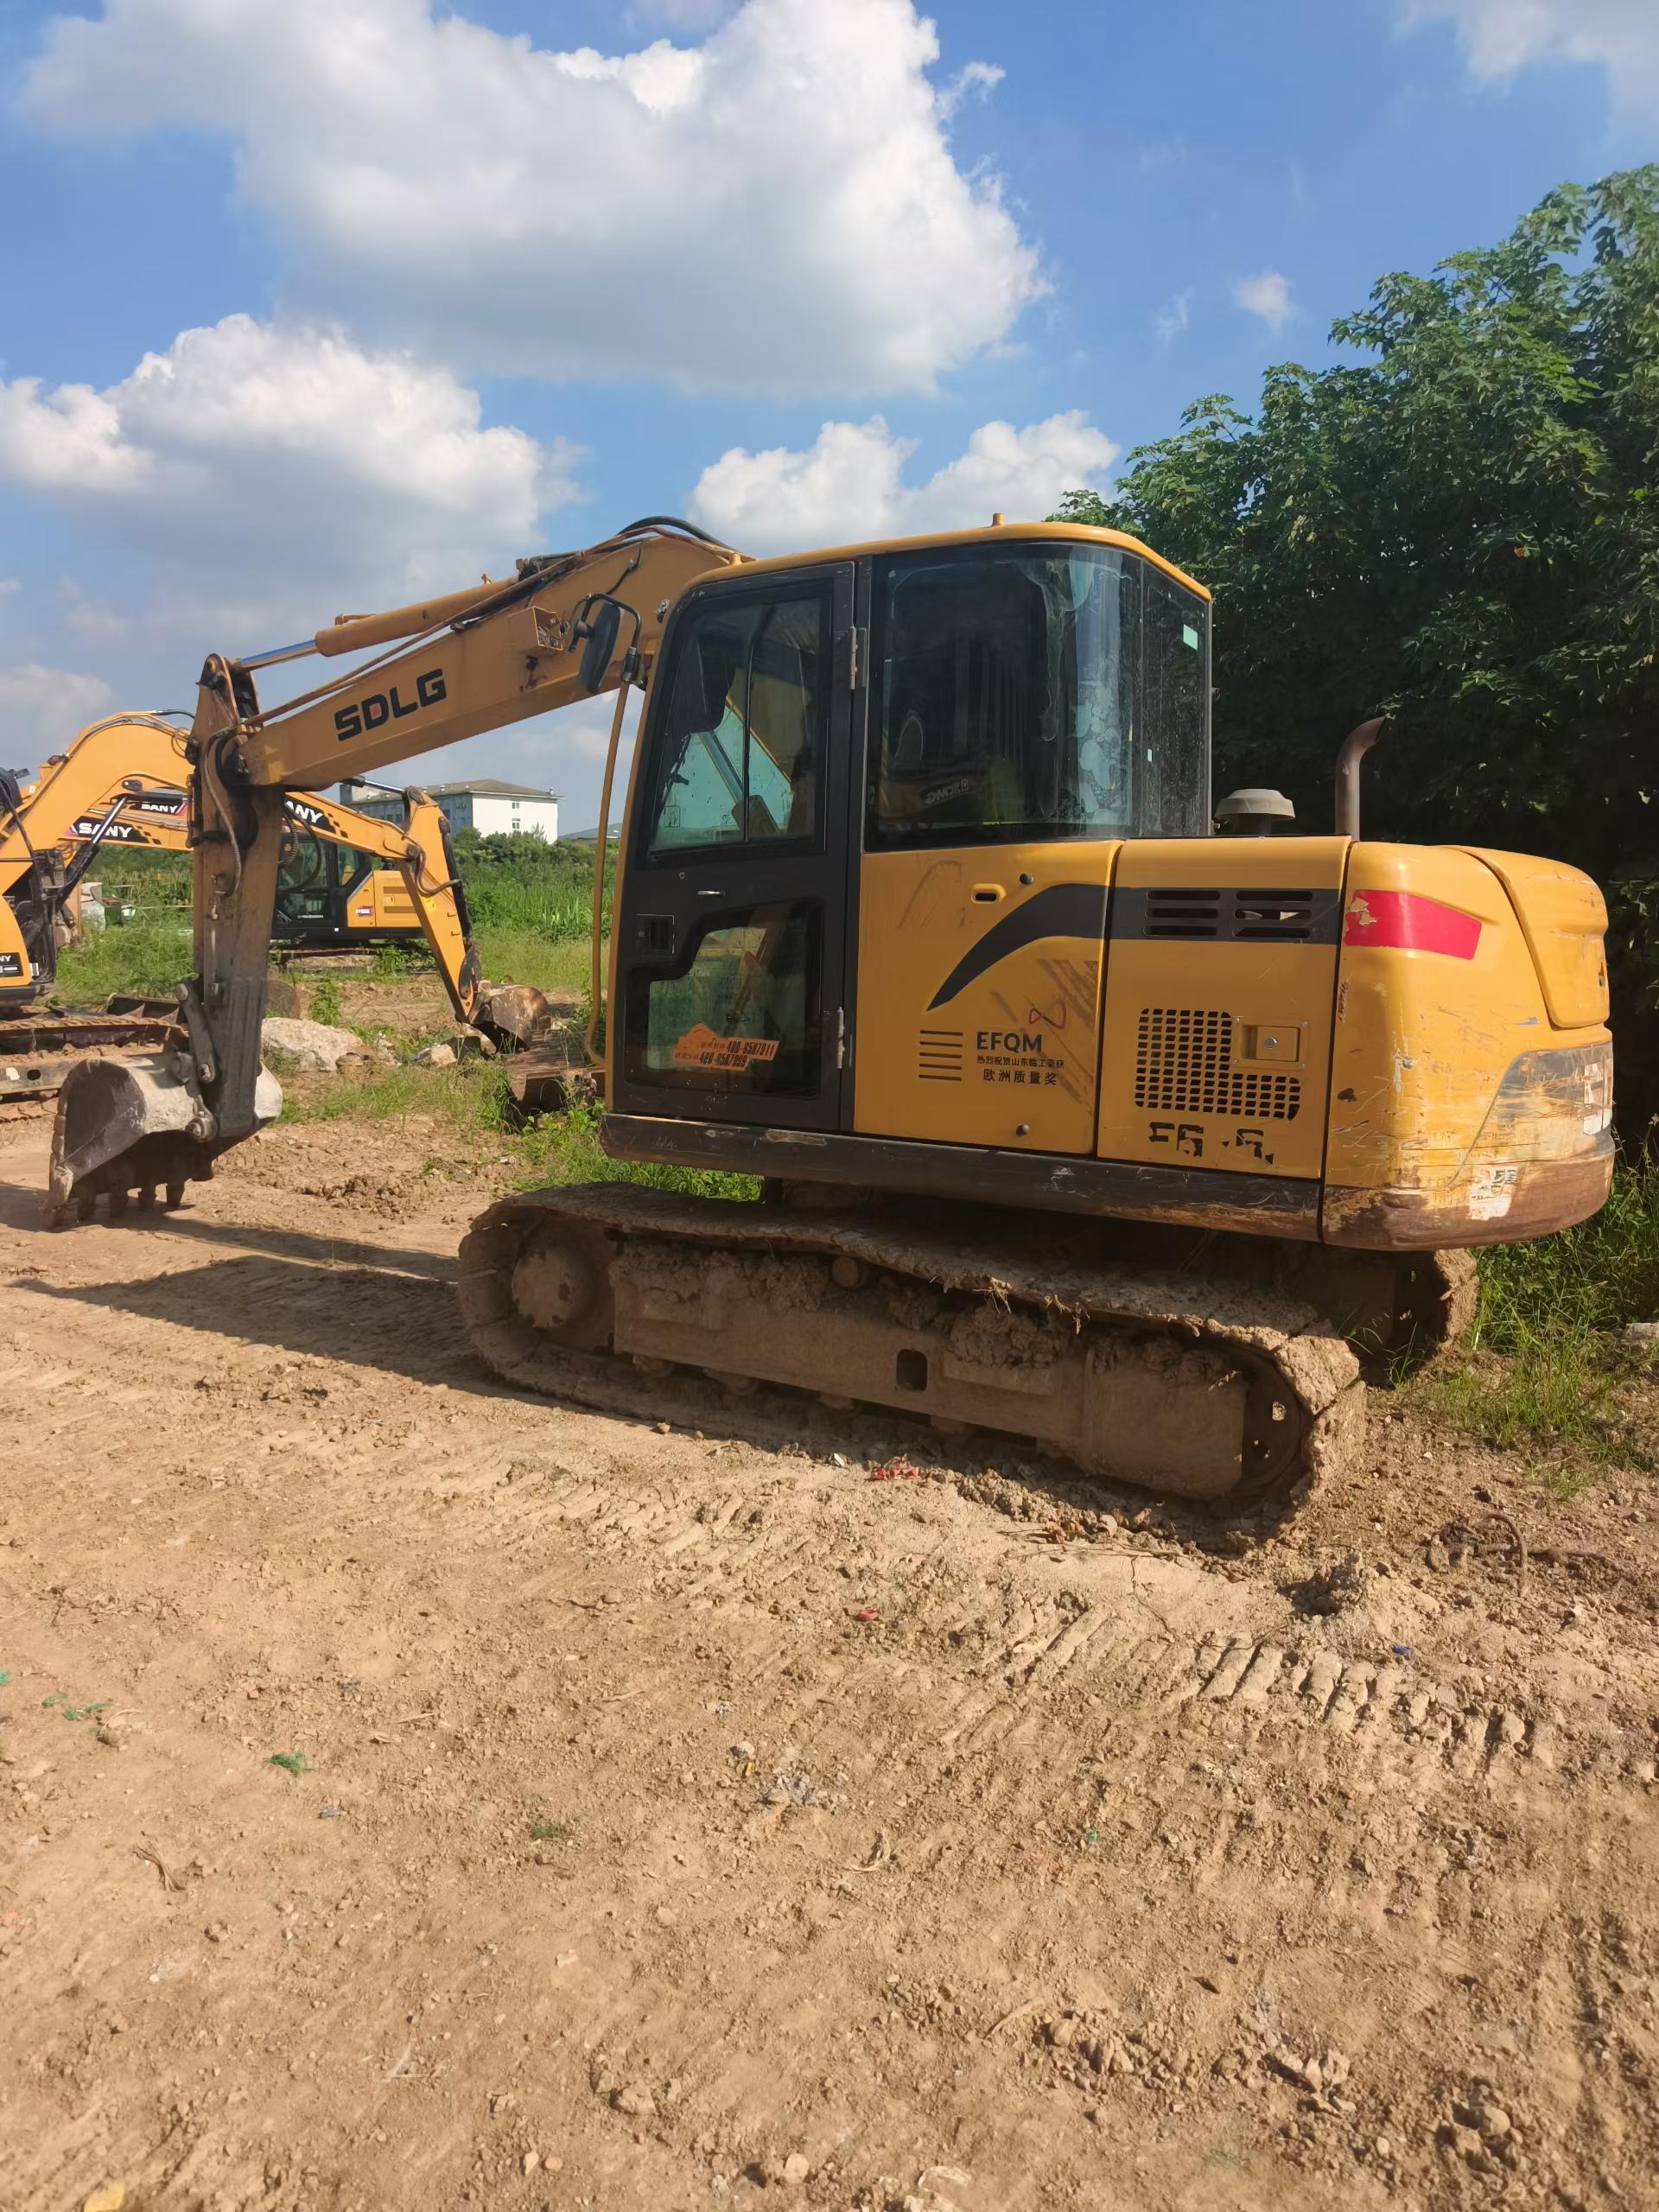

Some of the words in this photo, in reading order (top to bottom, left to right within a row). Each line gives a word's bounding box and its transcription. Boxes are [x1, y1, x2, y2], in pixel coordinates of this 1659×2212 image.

[334, 668, 447, 741] SDLG
[141, 803, 178, 813] SANY
[285, 800, 323, 823] ANY
[976, 1031, 1042, 1053] EFQM
[983, 1069, 1057, 1085] 欧洲质量奖
